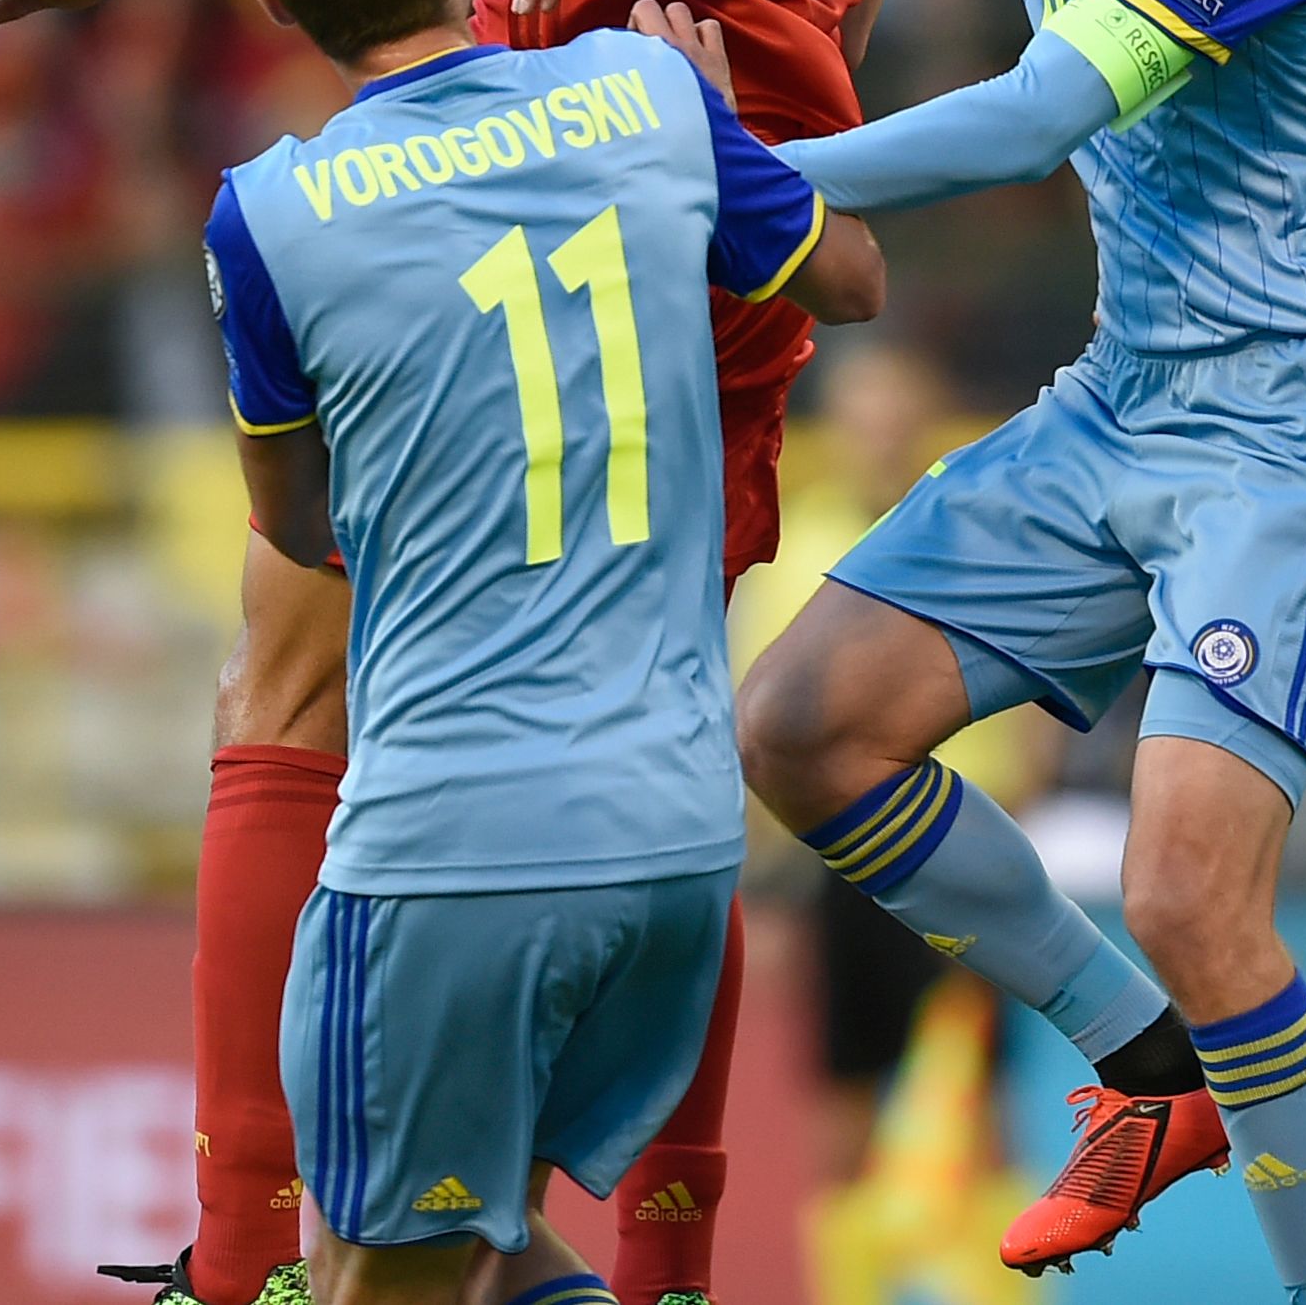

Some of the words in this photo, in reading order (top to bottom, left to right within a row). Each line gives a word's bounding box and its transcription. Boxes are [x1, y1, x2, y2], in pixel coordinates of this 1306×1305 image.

[1125, 27, 1166, 91] RESPEC
[293, 68, 661, 221] VOROGOVSKIY
[458, 204, 650, 565] 11
[635, 1205, 703, 1223] adidas
